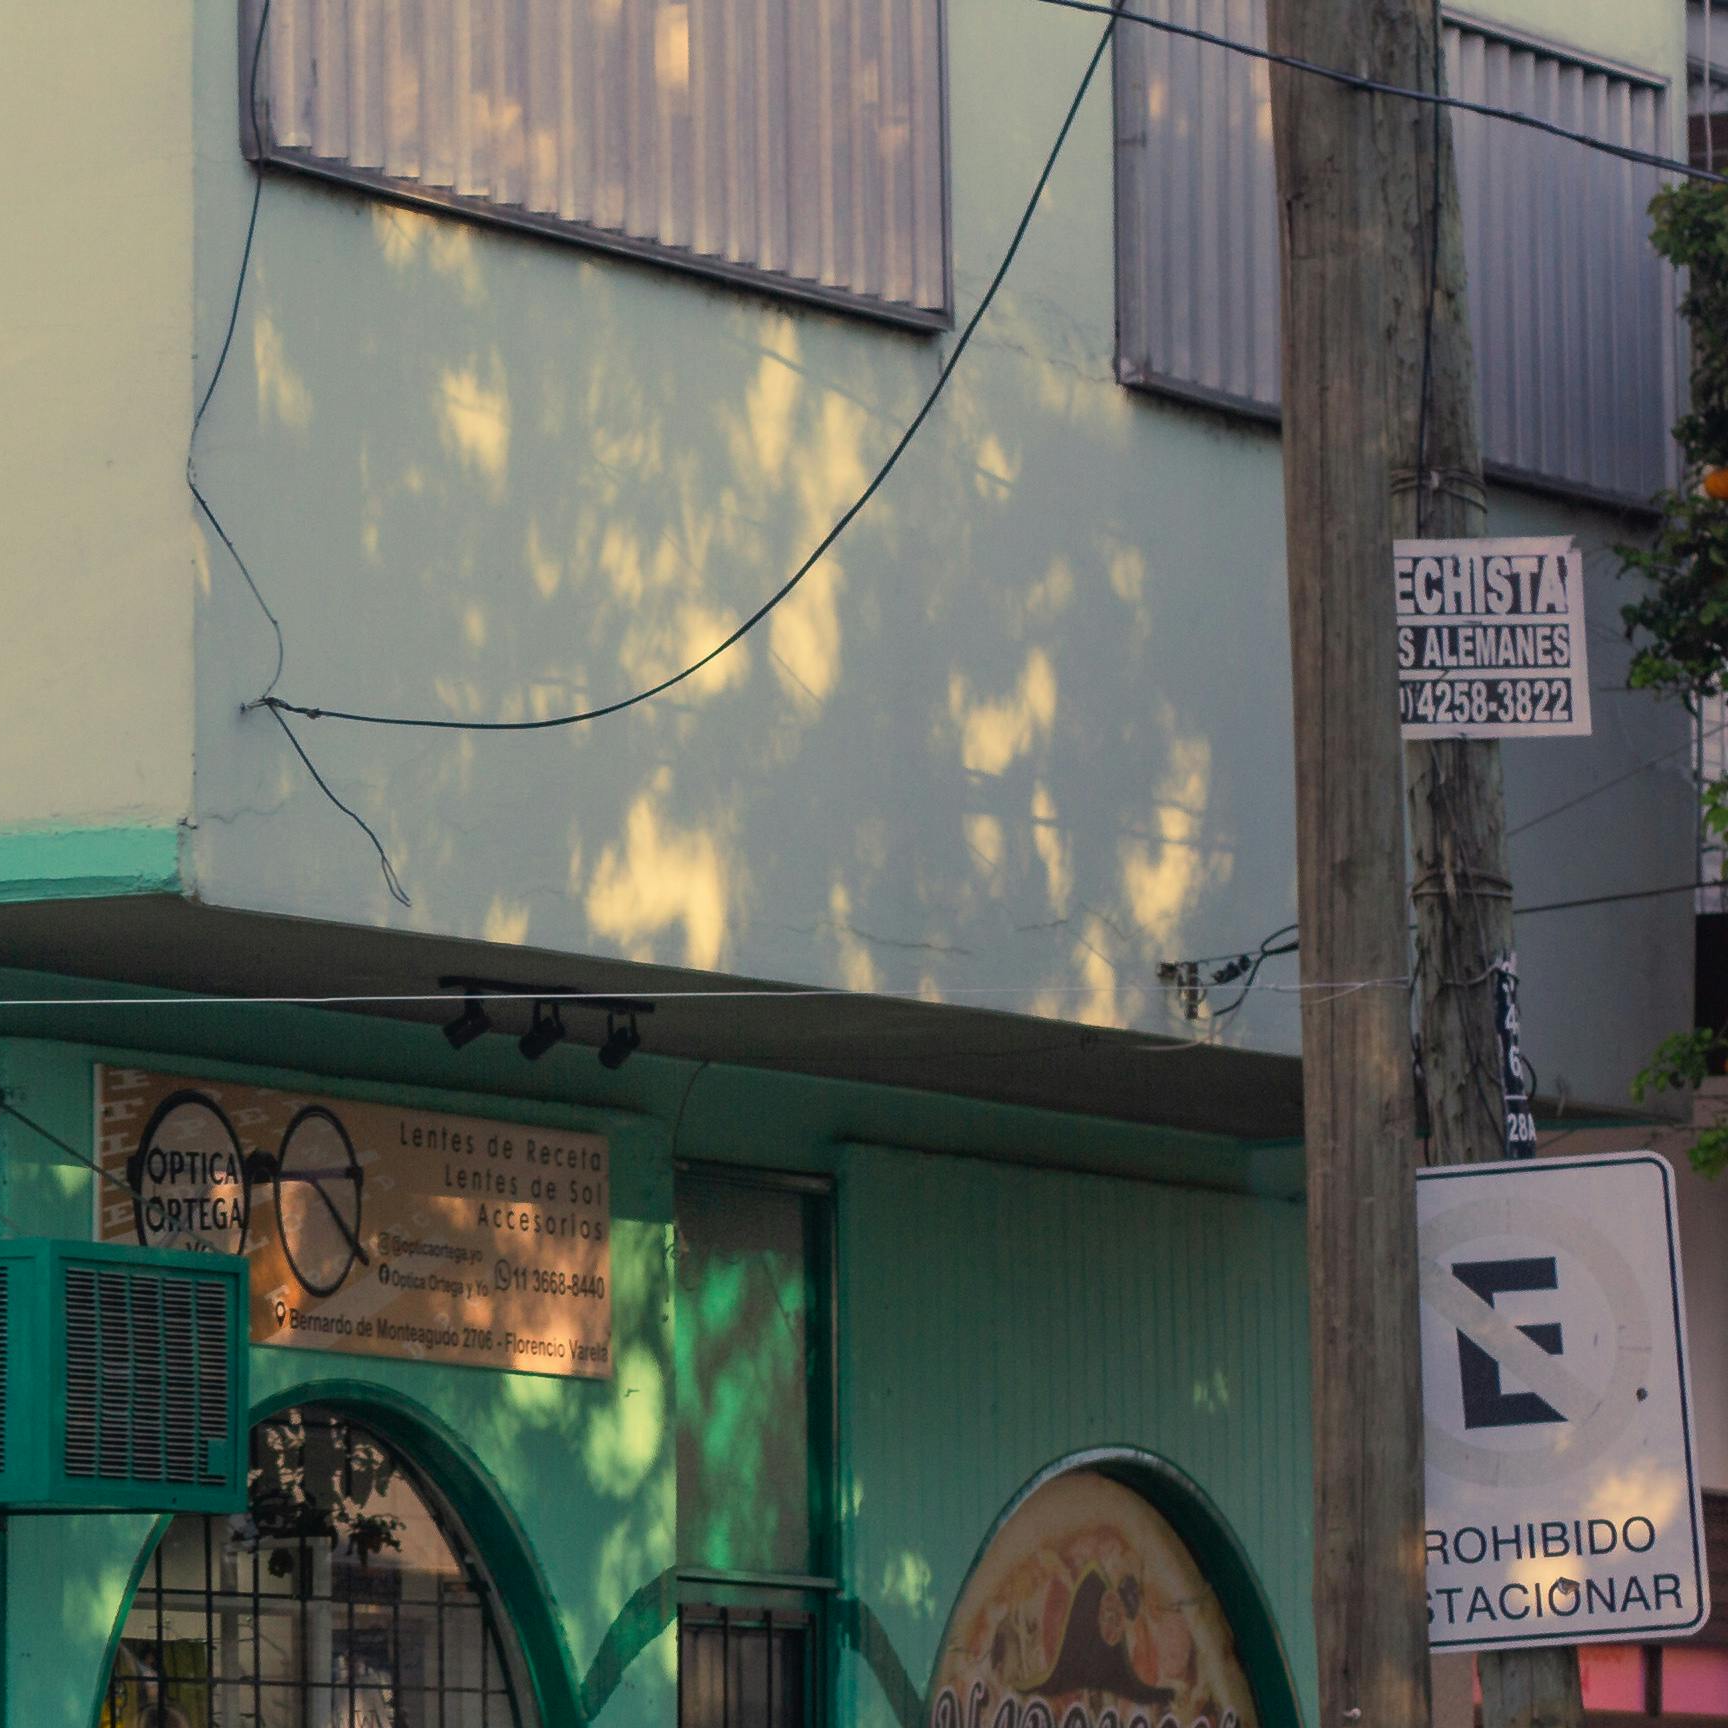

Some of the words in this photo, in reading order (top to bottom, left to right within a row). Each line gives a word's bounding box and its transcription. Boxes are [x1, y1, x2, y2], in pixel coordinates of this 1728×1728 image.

[1395, 557, 1567, 613] ECHISTA
[1423, 626, 1569, 667] ALEMANES
[1417, 680, 1569, 722] 4258-3822
[400, 1121, 474, 1154] Lentes
[487, 1135, 513, 1159] de
[527, 1139, 601, 1171] Receta
[445, 1164, 518, 1195] Lentes
[531, 1176, 556, 1200] de
[569, 1180, 602, 1205] Sol
[145, 1197, 244, 1232] ORTEGA
[477, 1203, 603, 1241] Accesorios
[513, 1268, 528, 1290] 11
[290, 1309, 352, 1336] Bernardo
[356, 1316, 373, 1337] de
[377, 1319, 459, 1350] Monteagudo
[463, 1328, 492, 1350] 2706
[505, 1332, 566, 1358] Florencio
[569, 1340, 608, 1363] Varela
[1425, 1517, 1656, 1566] ROHIBIDO
[1426, 1573, 1683, 1625] TACIONAR
